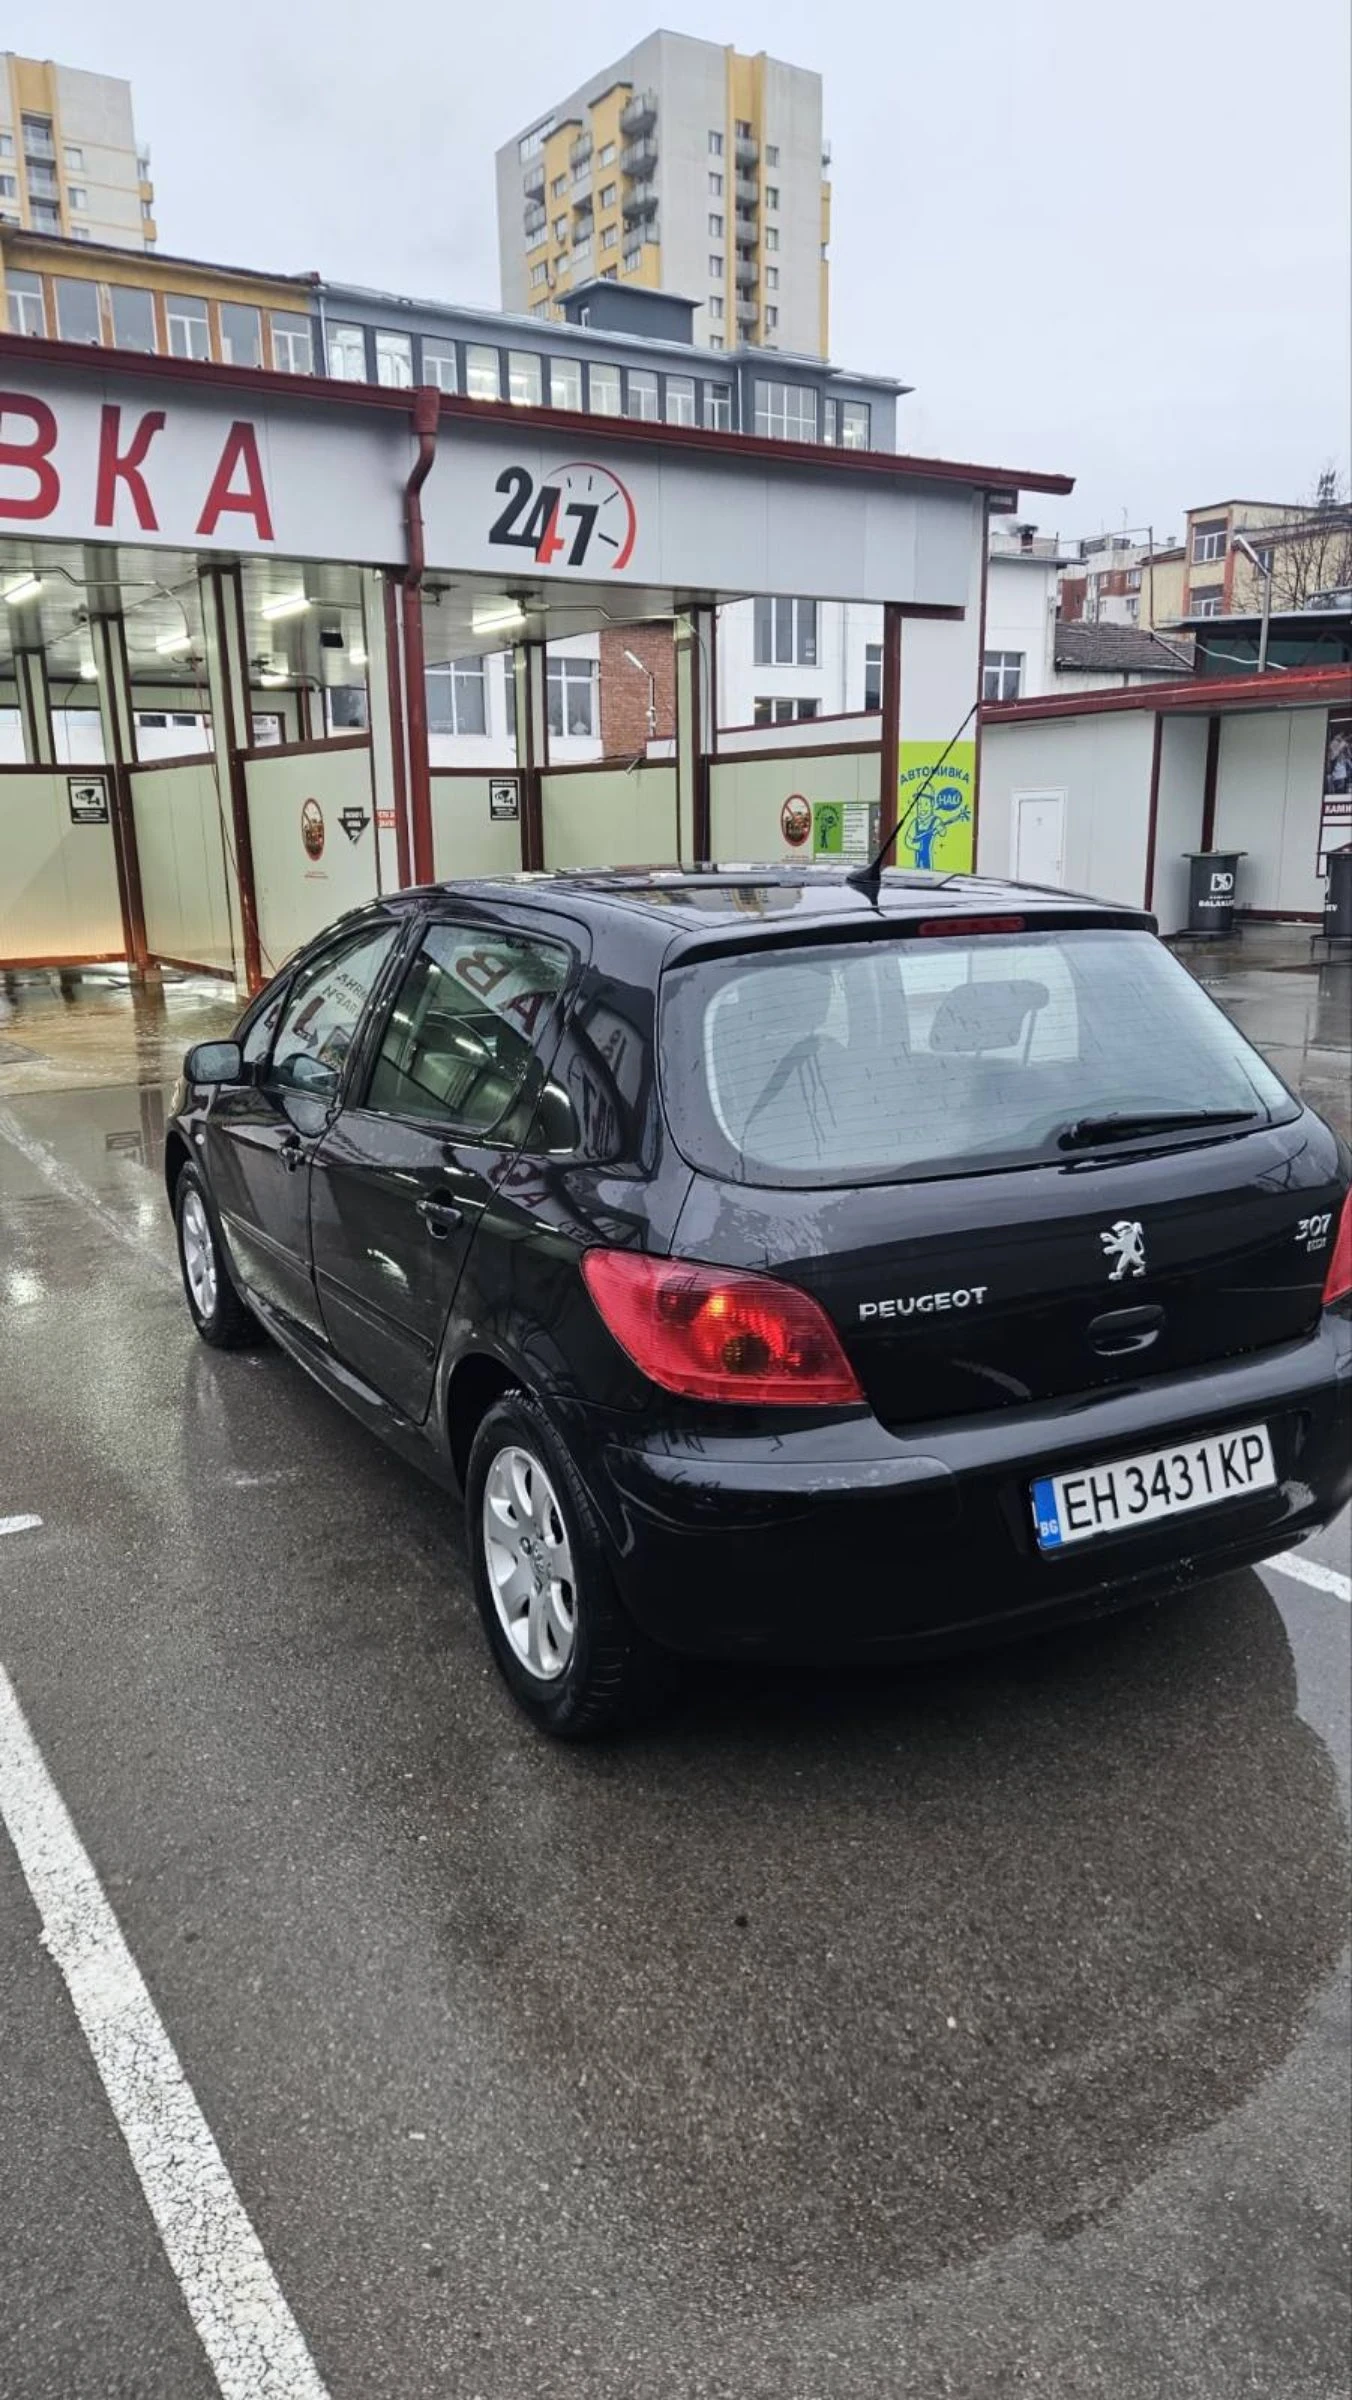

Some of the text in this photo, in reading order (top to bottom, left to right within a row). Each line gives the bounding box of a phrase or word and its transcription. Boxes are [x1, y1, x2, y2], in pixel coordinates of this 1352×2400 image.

[1294, 1213, 1332, 1240] 307
[859, 1287, 988, 1321] PEUGEOT
[1040, 1520, 1059, 1537] BG
